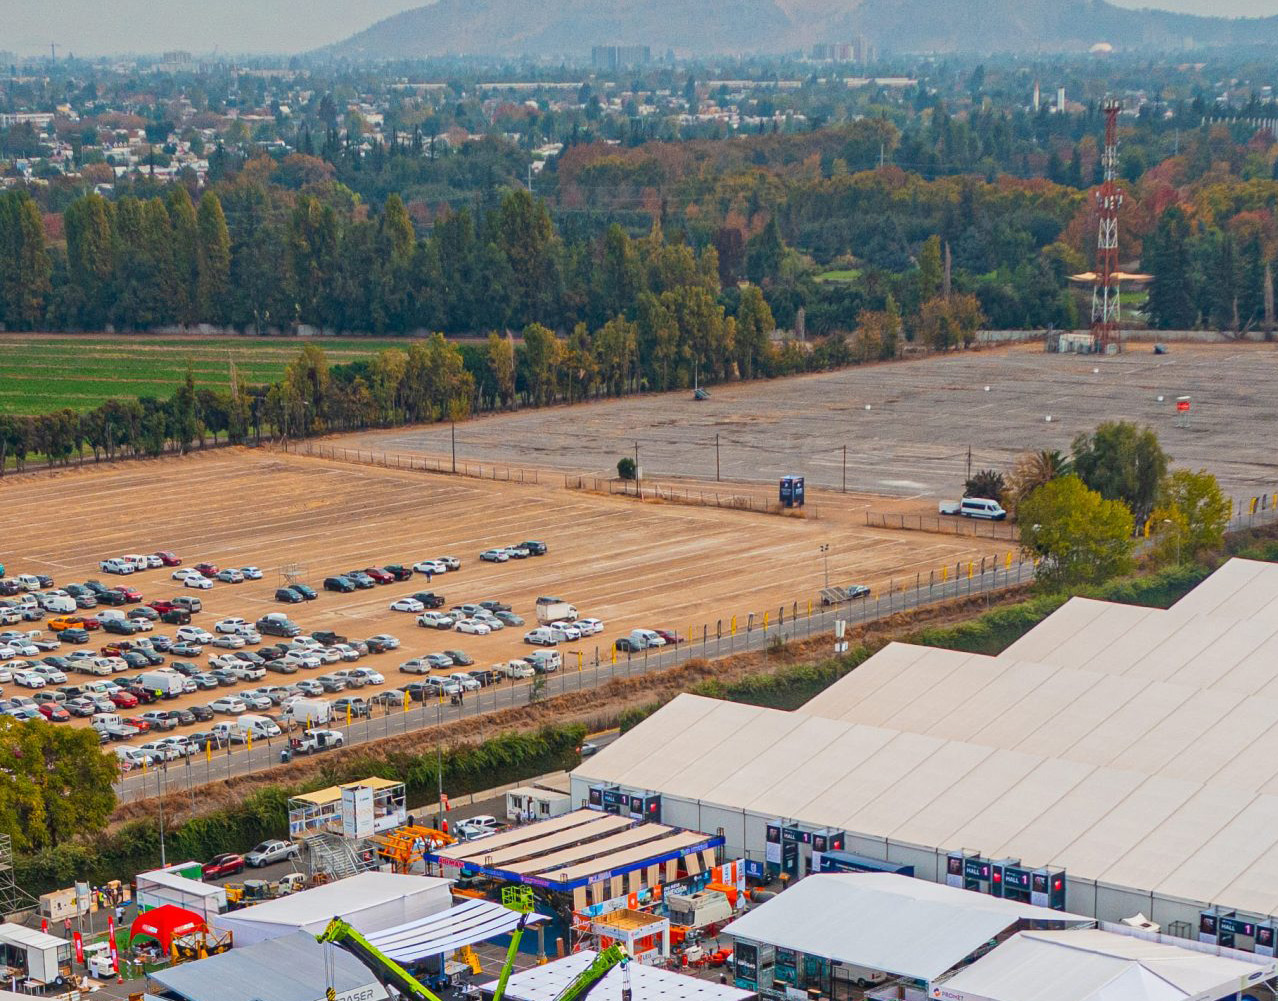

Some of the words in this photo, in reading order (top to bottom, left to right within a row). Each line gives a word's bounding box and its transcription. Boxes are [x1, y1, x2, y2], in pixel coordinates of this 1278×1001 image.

[784, 832, 796, 840] HALL
[966, 868, 980, 876] HALL
[983, 867, 988, 876] 1
[1005, 876, 1019, 884] HALL
[1022, 875, 1027, 885] 1
[1220, 924, 1236, 932] HALL
[1245, 925, 1251, 933] 1
